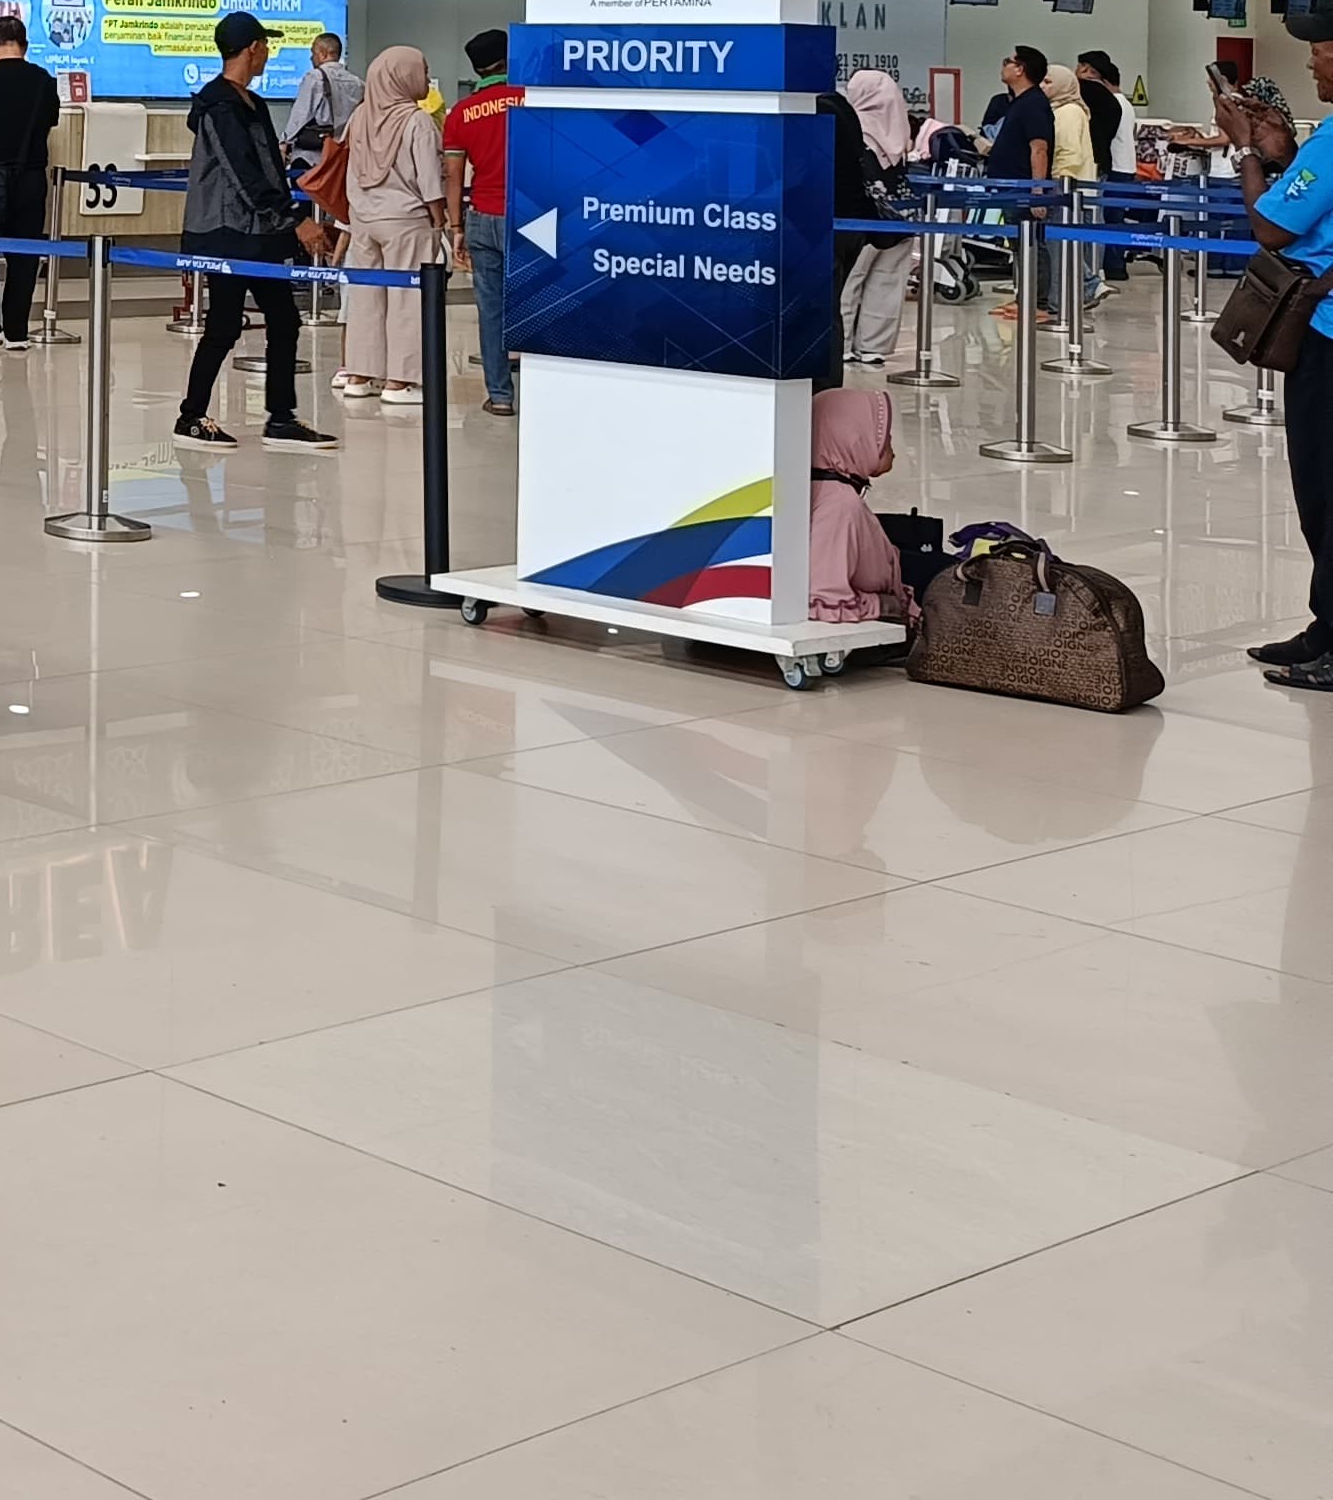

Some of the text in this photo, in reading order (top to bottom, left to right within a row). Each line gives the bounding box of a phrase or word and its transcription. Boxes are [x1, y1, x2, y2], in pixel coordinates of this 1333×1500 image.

[599, 0, 632, 8] member
[635, 0, 644, 7] of
[120, 20, 159, 29] Jamkrindo
[563, 40, 734, 74] PRIORITY
[853, 54, 871, 69] 571
[874, 55, 899, 69] 1910
[583, 196, 777, 231] Premium Class
[176, 258, 222, 271] PELITA AIR
[593, 249, 776, 285] Special Needs
[291, 268, 339, 281] PELITA AIR
